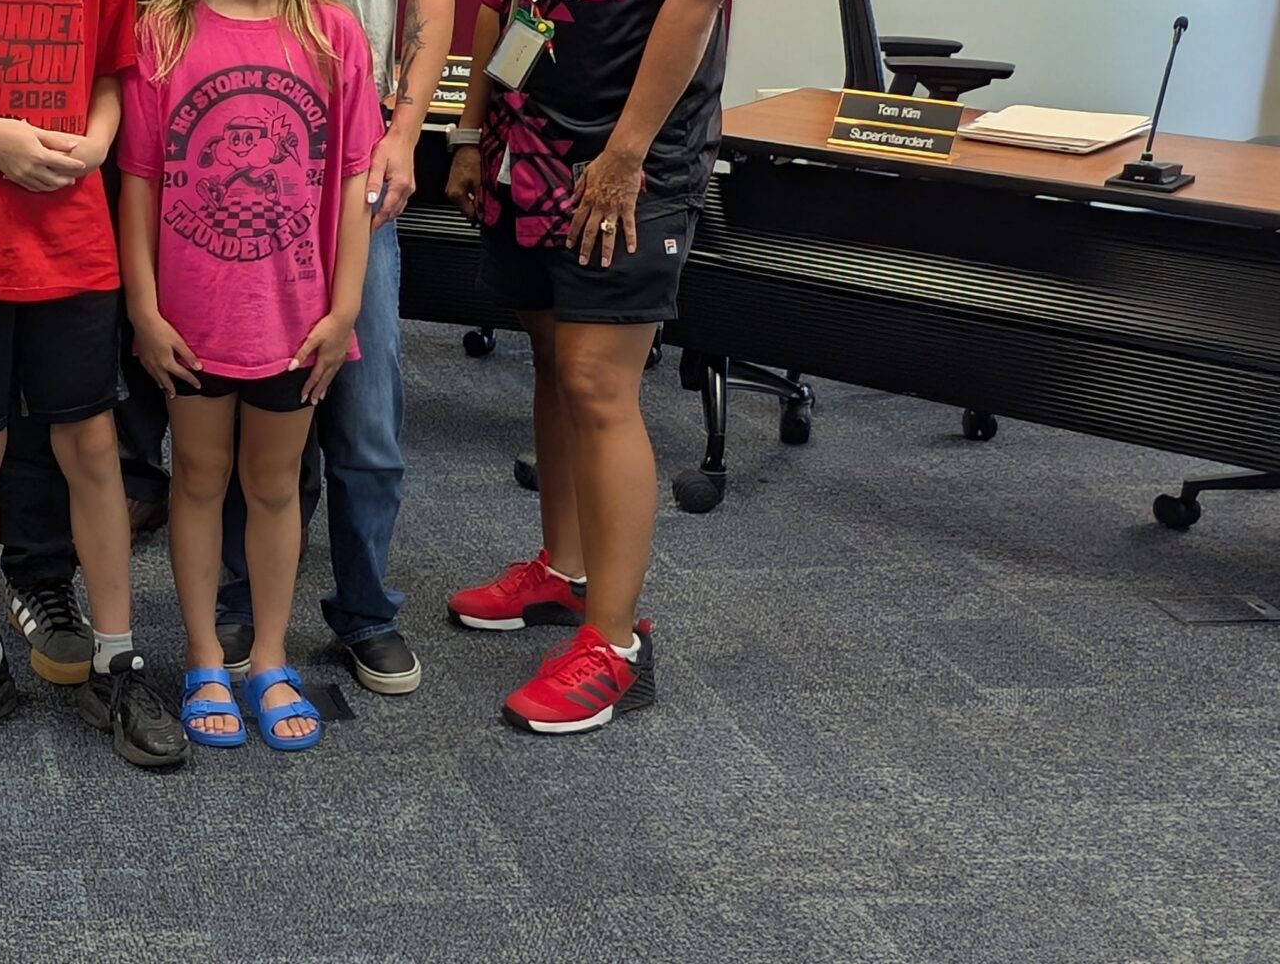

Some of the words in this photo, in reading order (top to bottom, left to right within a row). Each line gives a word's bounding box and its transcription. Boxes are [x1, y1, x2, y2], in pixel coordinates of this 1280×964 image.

[3, 42, 79, 84] RUN
[9, 90, 66, 109] 2026
[170, 104, 197, 135] HC
[192, 70, 263, 109] STORM
[265, 73, 327, 133] SCHOOL
[878, 103, 899, 117] Tom
[901, 106, 921, 120] Kim
[849, 127, 934, 149] Superintendent
[163, 199, 273, 262] THUNDER
